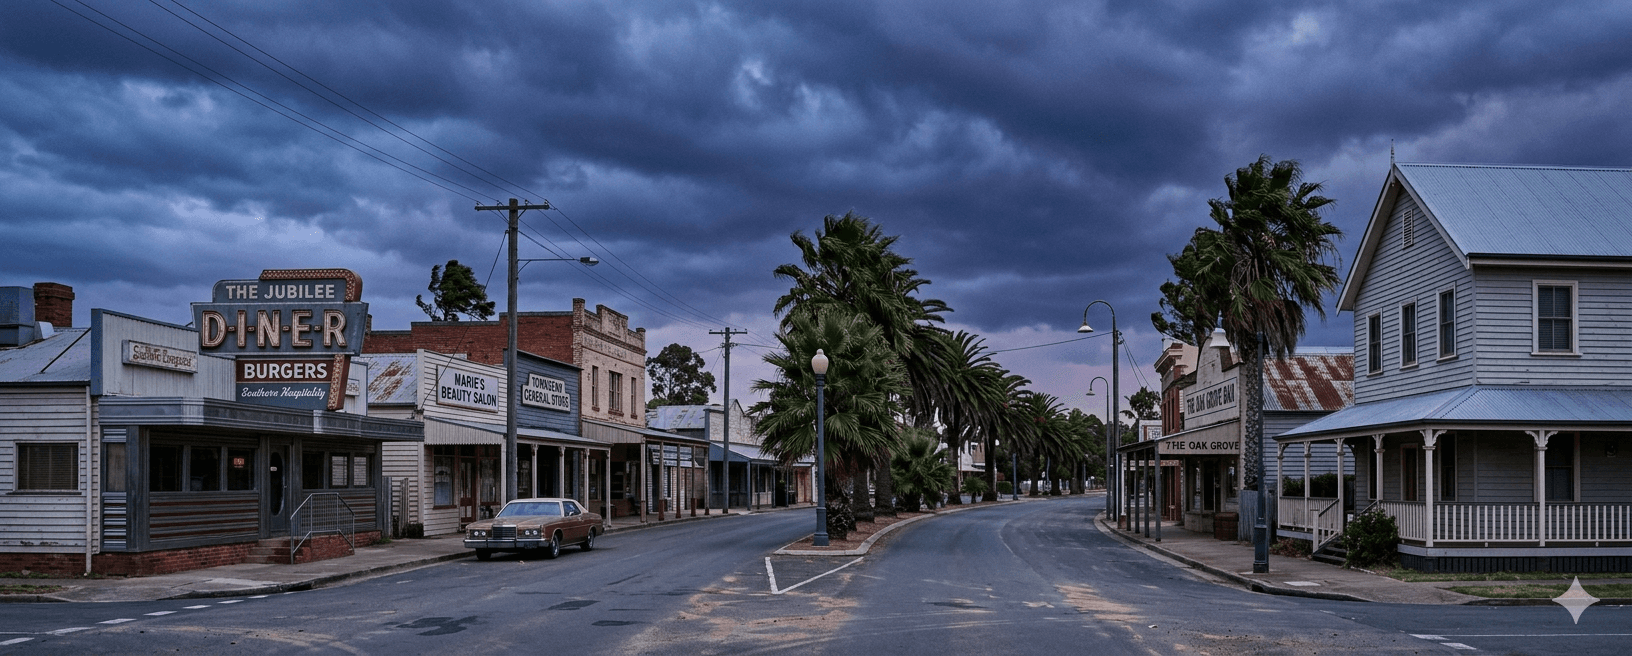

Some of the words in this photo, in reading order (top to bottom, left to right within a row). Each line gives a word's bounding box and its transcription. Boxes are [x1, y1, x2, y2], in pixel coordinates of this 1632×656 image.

[226, 285, 258, 299] THE
[264, 284, 335, 299] JUBILEE
[244, 363, 328, 379] BURGERS
[441, 386, 472, 402] BEAUTY
[473, 392, 497, 407] SALON
[1188, 441, 1208, 450] OAK
[1210, 441, 1240, 450] GROVE
